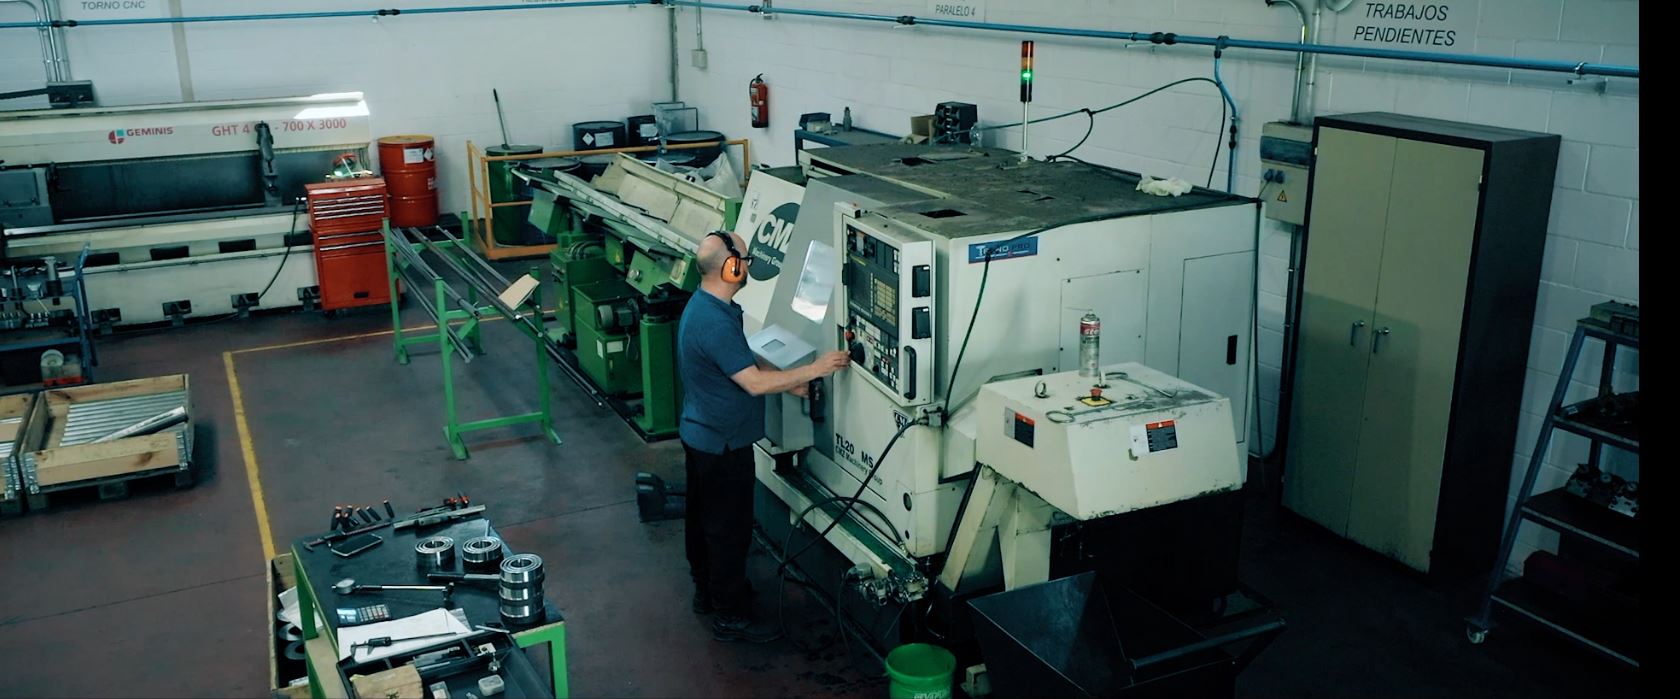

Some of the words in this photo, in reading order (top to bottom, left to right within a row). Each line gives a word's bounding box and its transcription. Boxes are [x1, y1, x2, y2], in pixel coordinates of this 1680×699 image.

[81, 1, 120, 10] TORNO
[123, 0, 146, 9] CNC
[935, 4, 970, 17] PARALELO
[971, 6, 976, 16] 4
[1366, 3, 1449, 21] TRABAJOS
[1354, 26, 1456, 46] PENDIENTES
[126, 127, 174, 137] GEMINIS
[212, 124, 239, 137] GHT
[242, 124, 250, 134] 4
[283, 121, 304, 132] 700
[320, 118, 347, 130] 3000
[835, 433, 855, 455] TL20
[861, 450, 874, 469] MS
